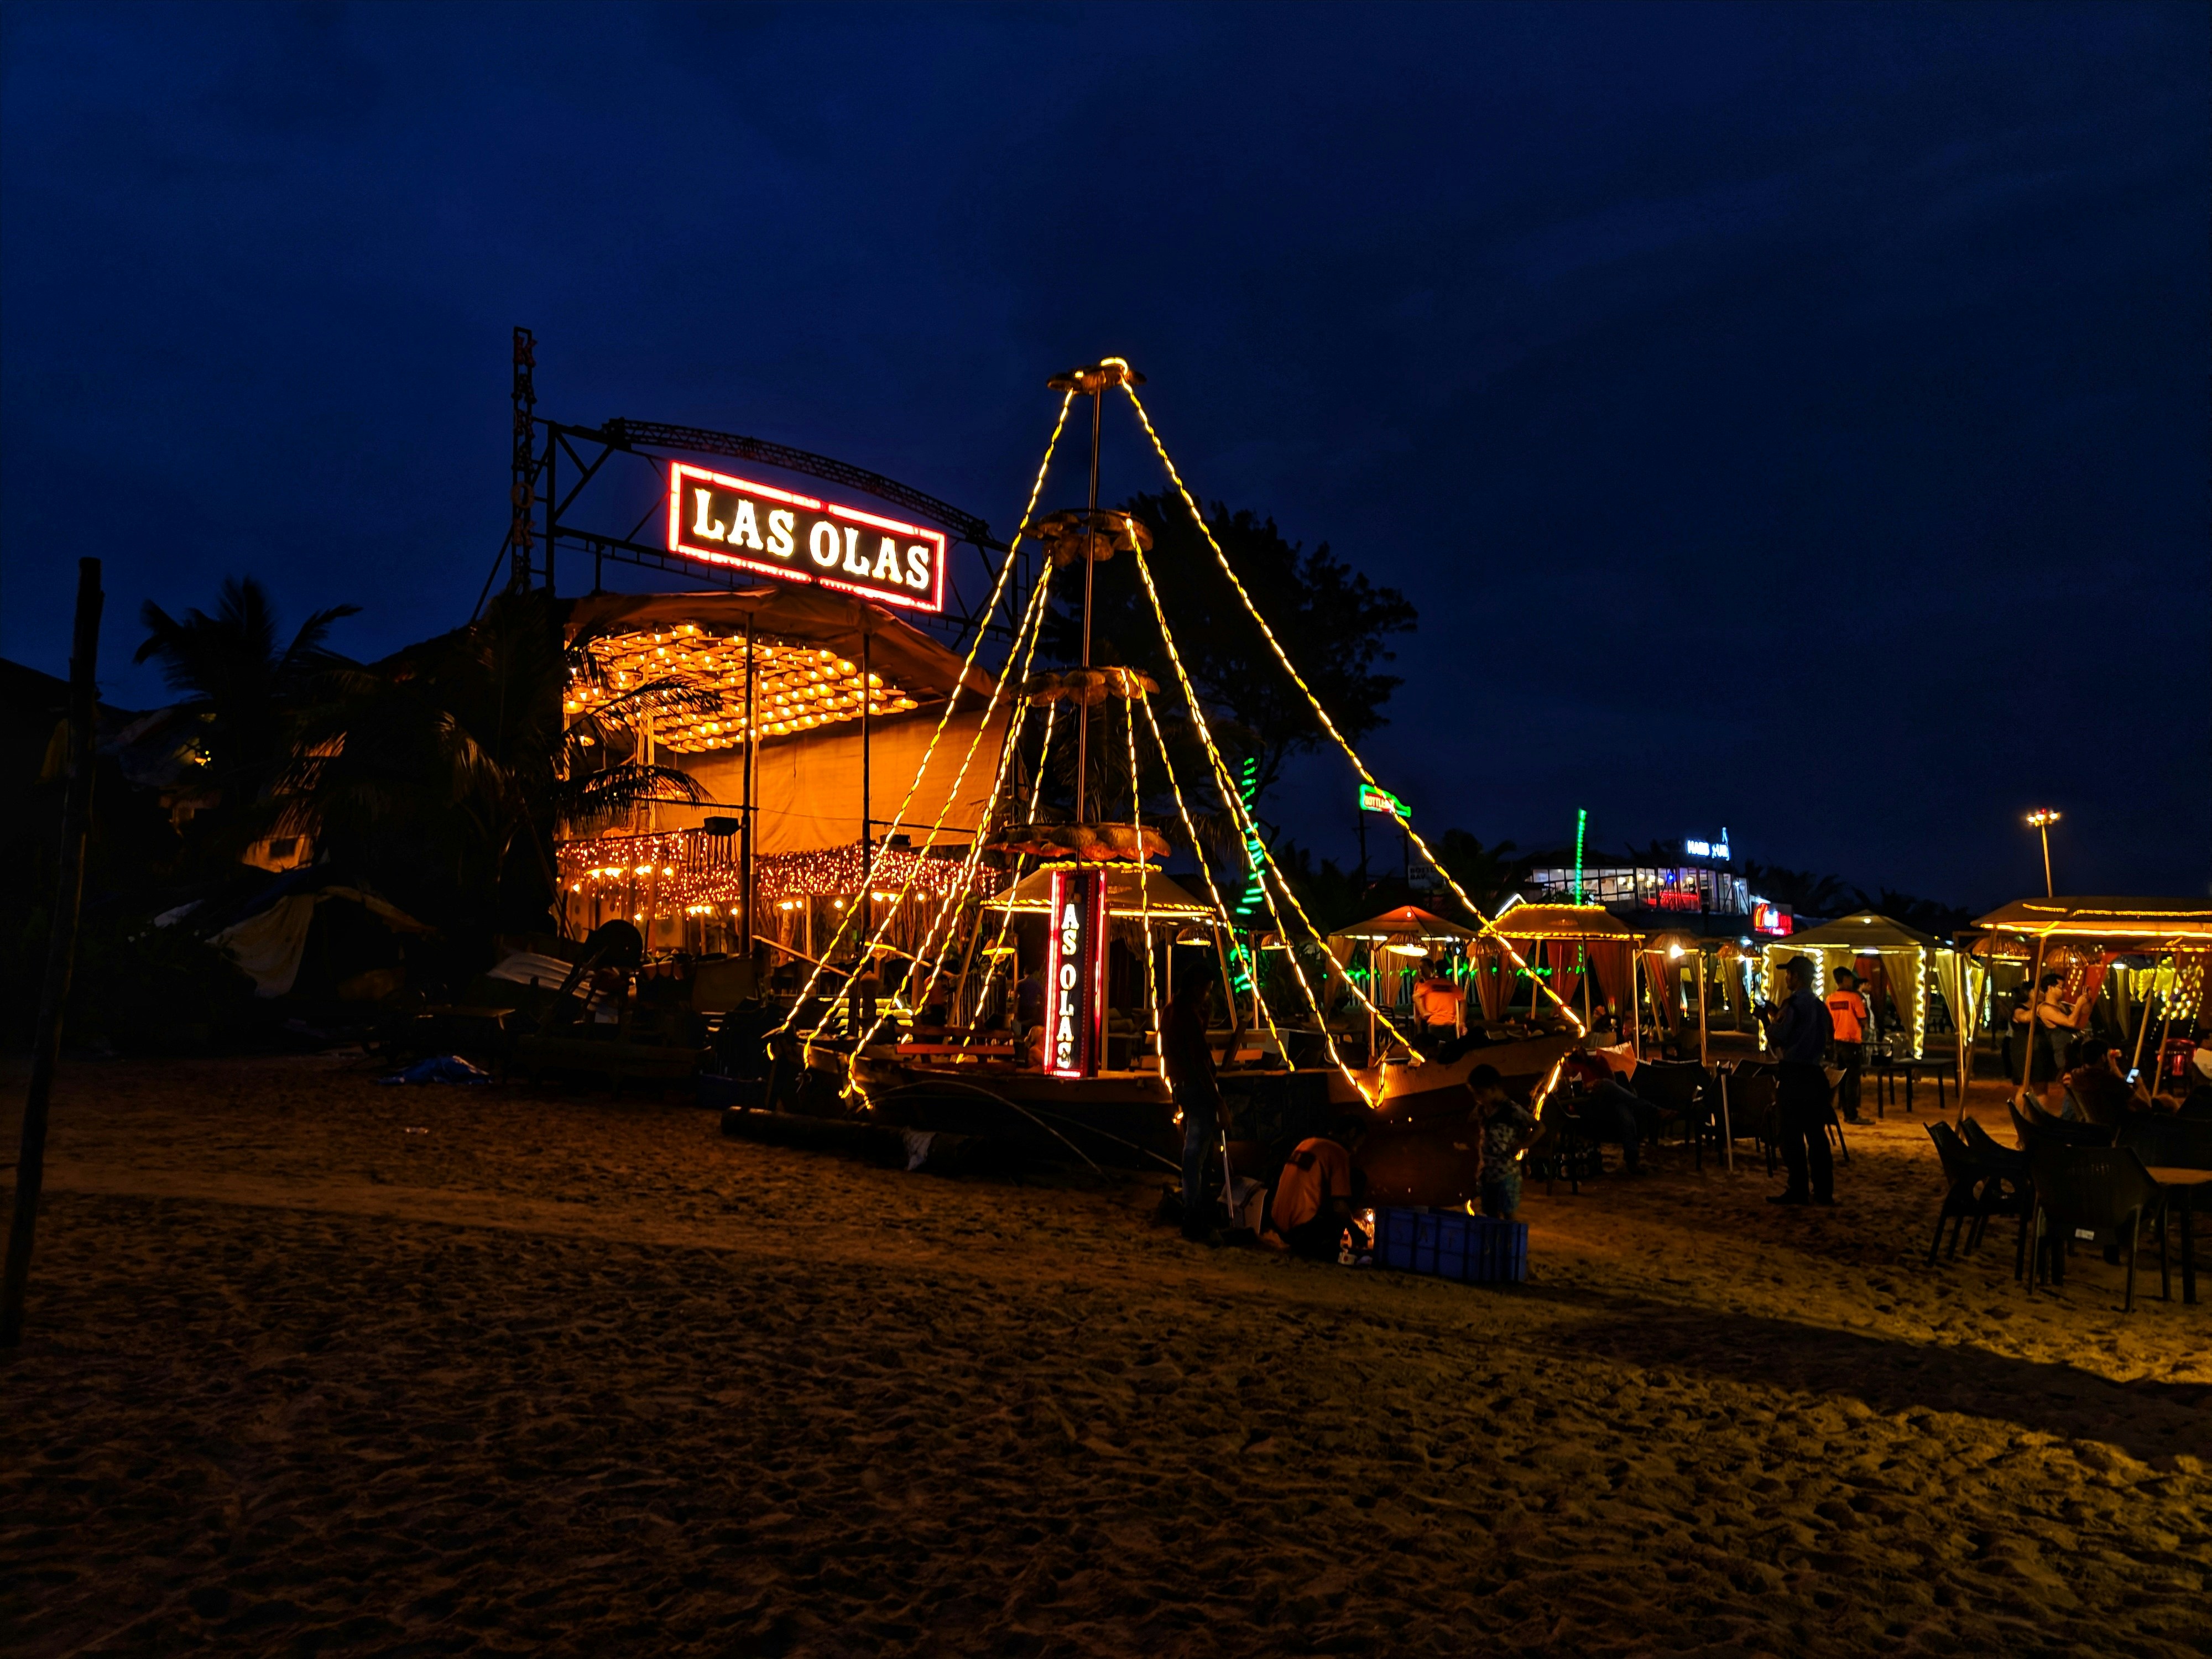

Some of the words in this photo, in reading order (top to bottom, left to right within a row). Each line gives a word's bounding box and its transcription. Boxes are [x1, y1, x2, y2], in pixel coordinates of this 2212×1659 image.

[692, 488, 795, 557] LAS
[809, 521, 930, 589] OLAS
[1057, 963, 1077, 1069] OLAS
